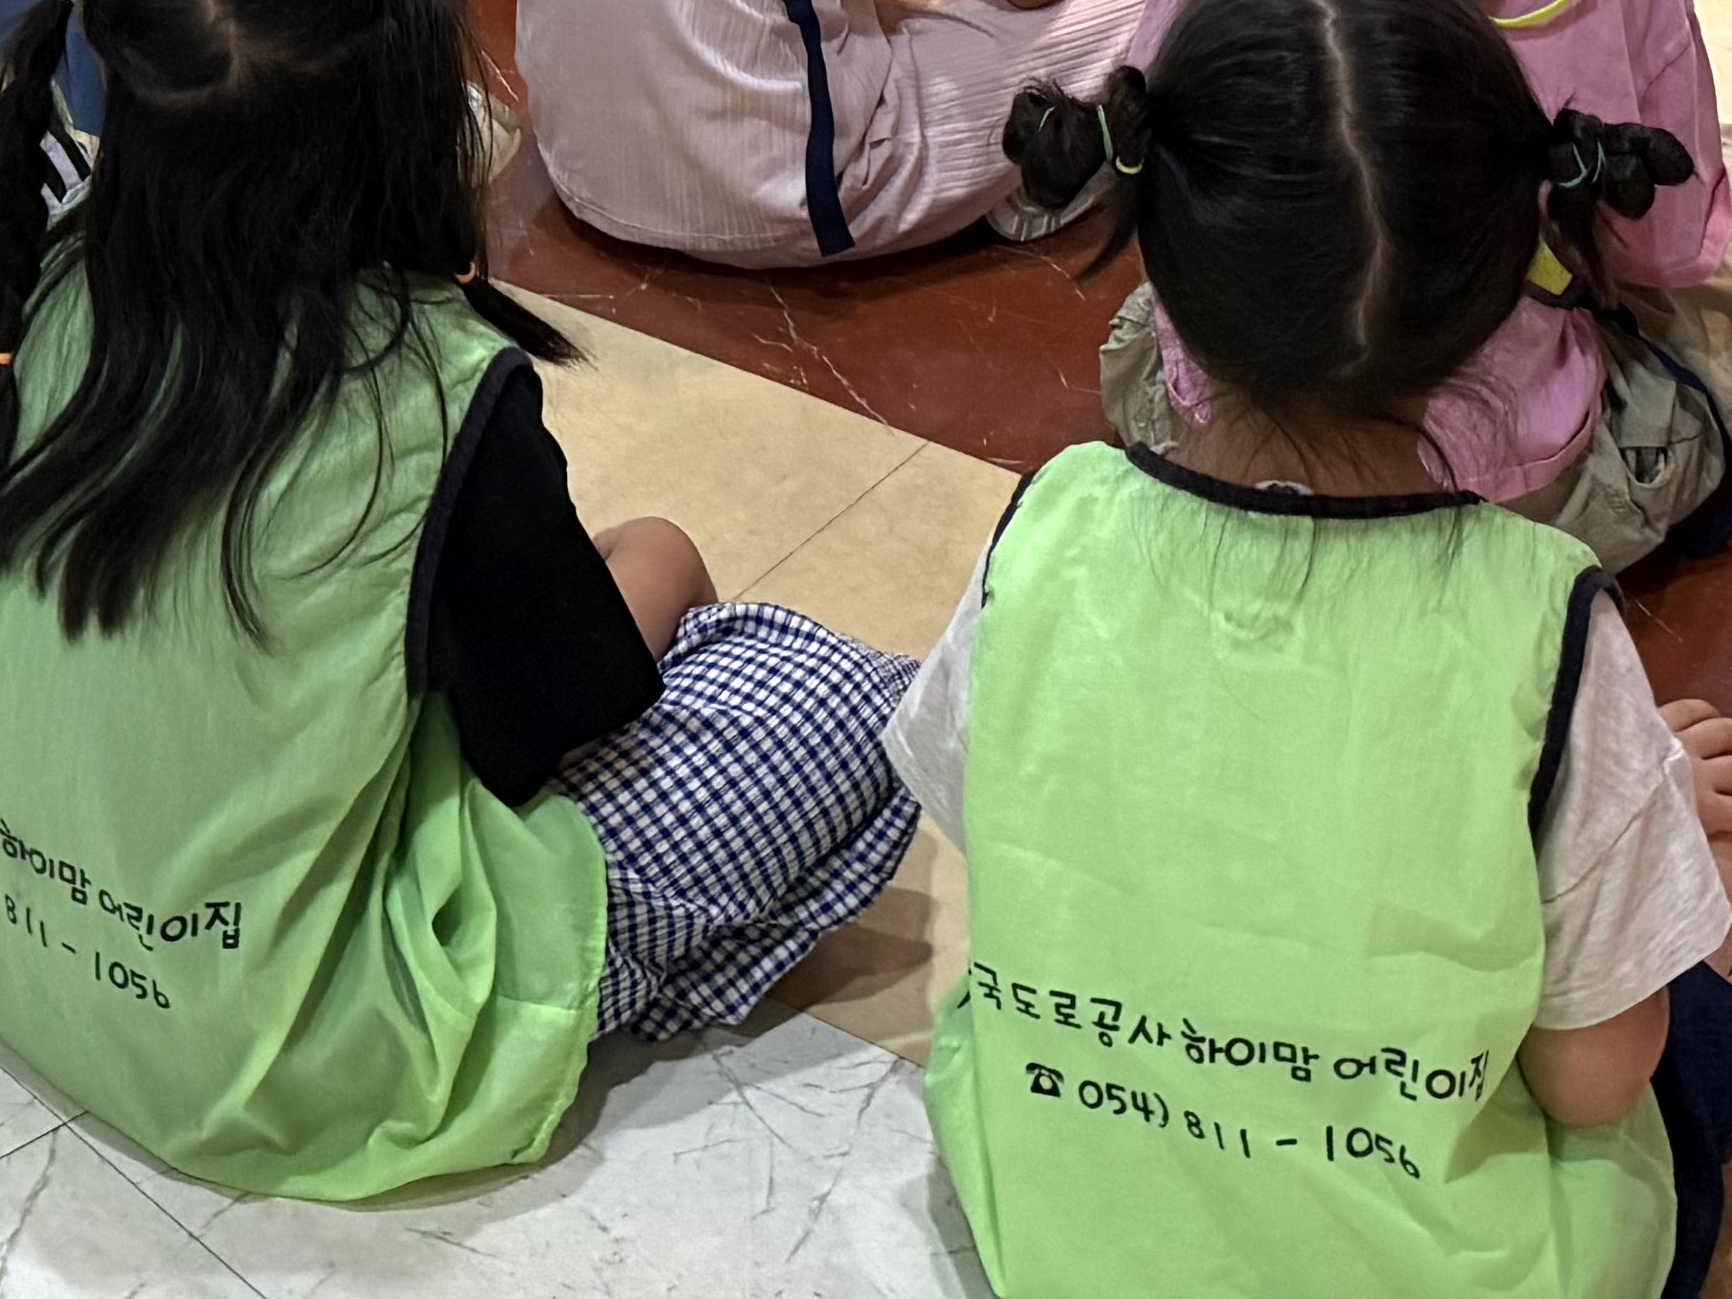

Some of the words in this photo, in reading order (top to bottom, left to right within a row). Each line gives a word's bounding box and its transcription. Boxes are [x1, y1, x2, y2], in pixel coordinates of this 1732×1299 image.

[98, 888, 242, 952] 어린이집
[968, 960, 1172, 1049] 국도로공사
[1179, 1016, 1321, 1084] 하이맘
